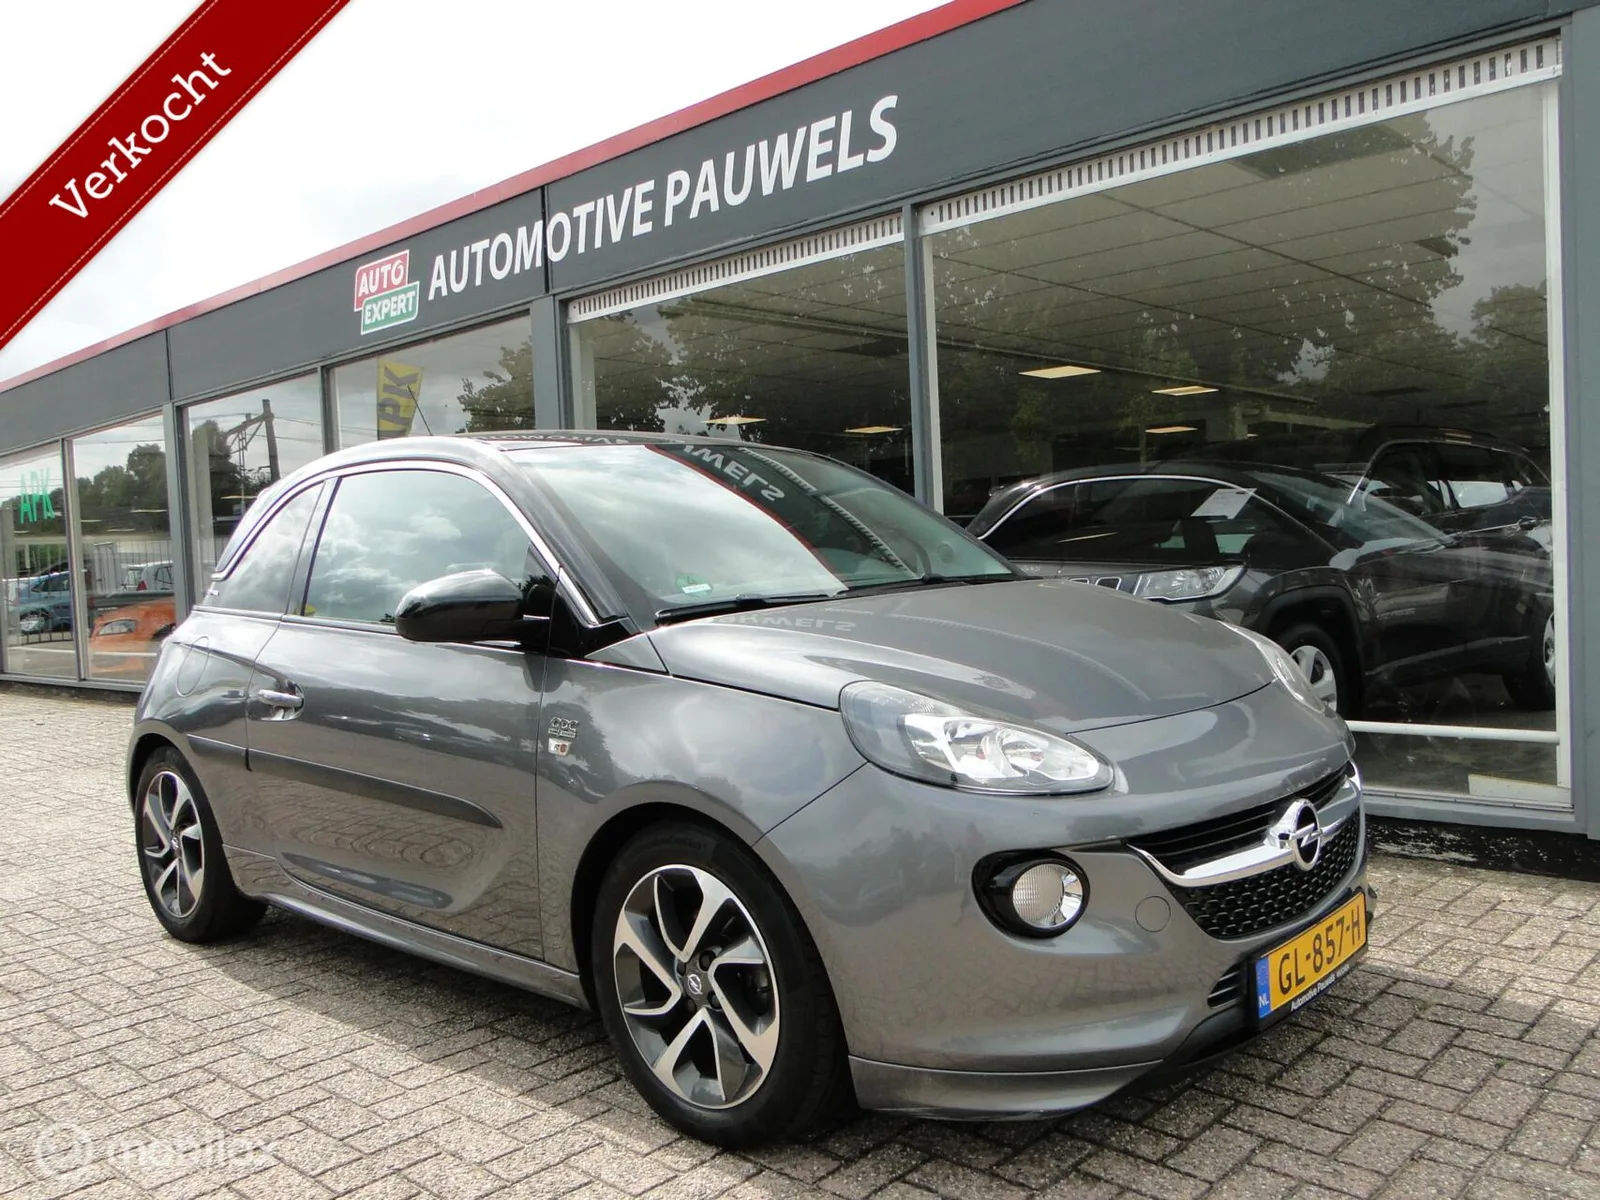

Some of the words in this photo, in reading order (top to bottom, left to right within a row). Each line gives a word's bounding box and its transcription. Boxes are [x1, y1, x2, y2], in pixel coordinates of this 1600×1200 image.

[428, 179, 655, 301] AUTOMOTIVE
[664, 95, 898, 227] PAUWELS
[358, 260, 405, 297] AUTO
[364, 291, 416, 325] EXPERT
[1278, 904, 1361, 996] GL-857-H
[1258, 995, 1270, 1008] NL
